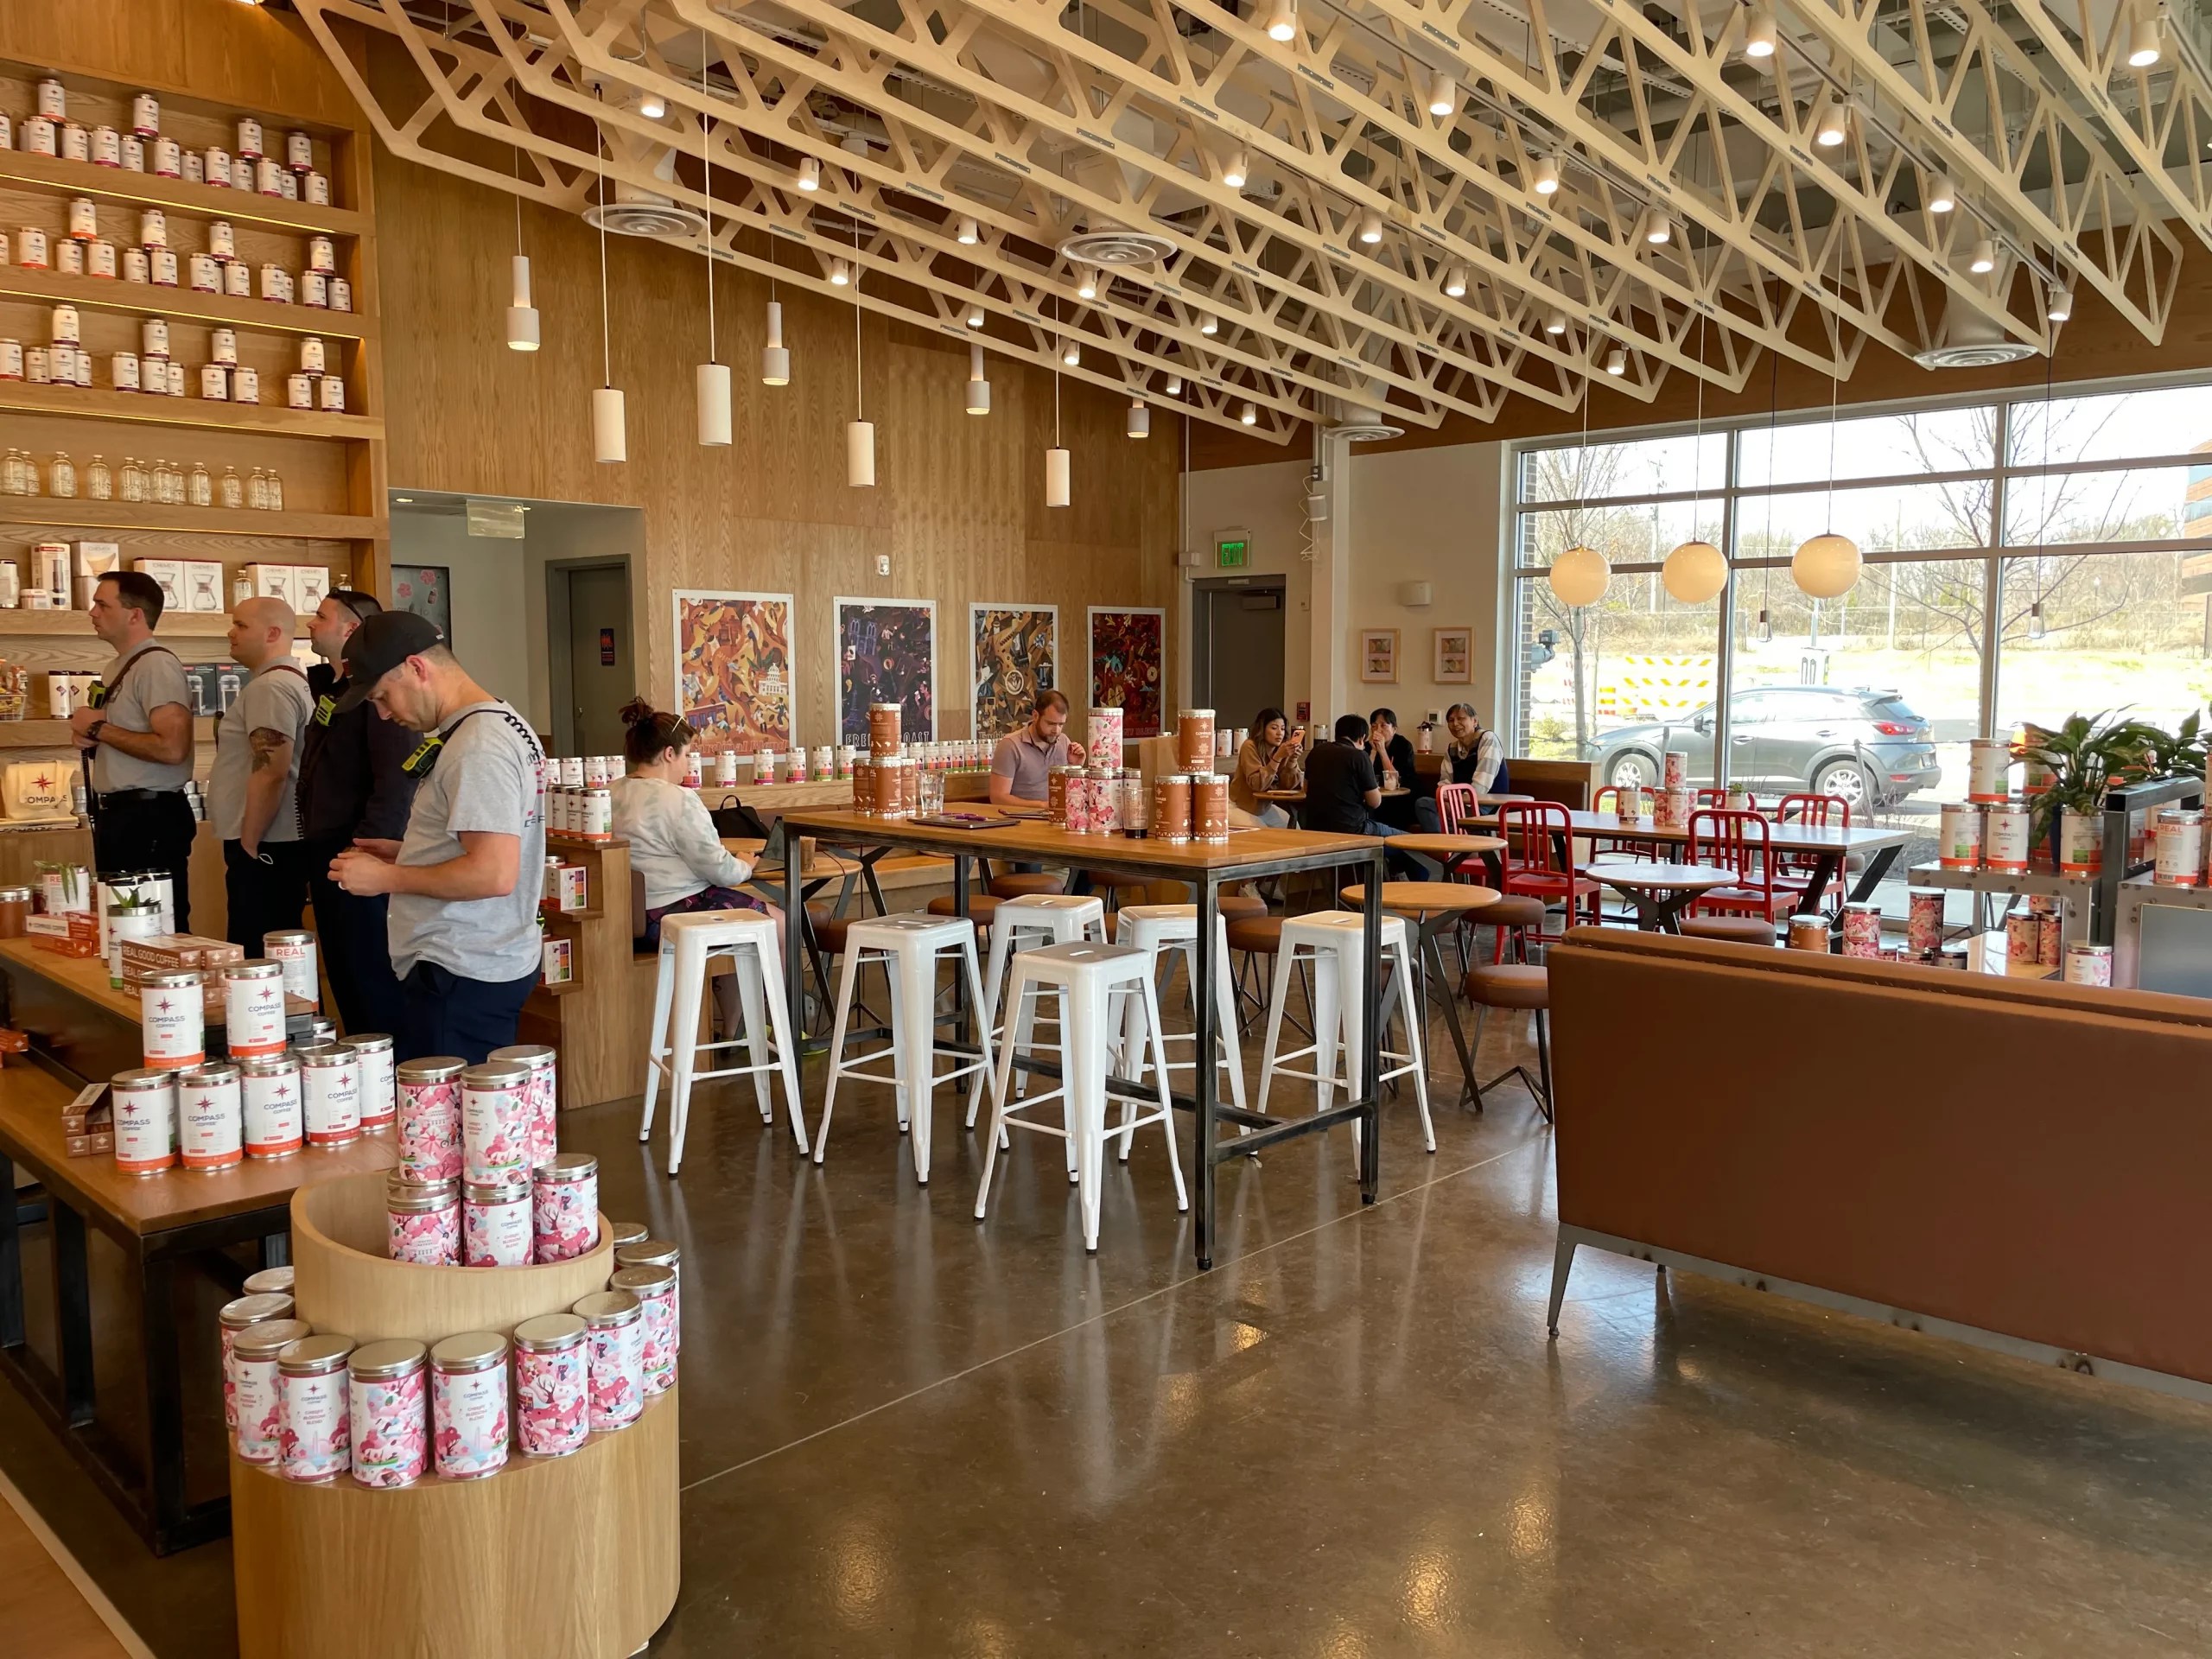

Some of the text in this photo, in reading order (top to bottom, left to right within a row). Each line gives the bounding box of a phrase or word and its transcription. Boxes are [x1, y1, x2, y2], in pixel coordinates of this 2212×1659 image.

[1222, 543, 1244, 566] EXIT
[2159, 824, 2183, 833] REAL
[123, 945, 180, 968] REAL GOOD COFFEE
[276, 947, 306, 957] REAL
[248, 1001, 283, 1013] COMPASS
[148, 1014, 186, 1023] COMPASS
[264, 1099, 298, 1110] COMPASS
[188, 1113, 226, 1122] COMPASS
